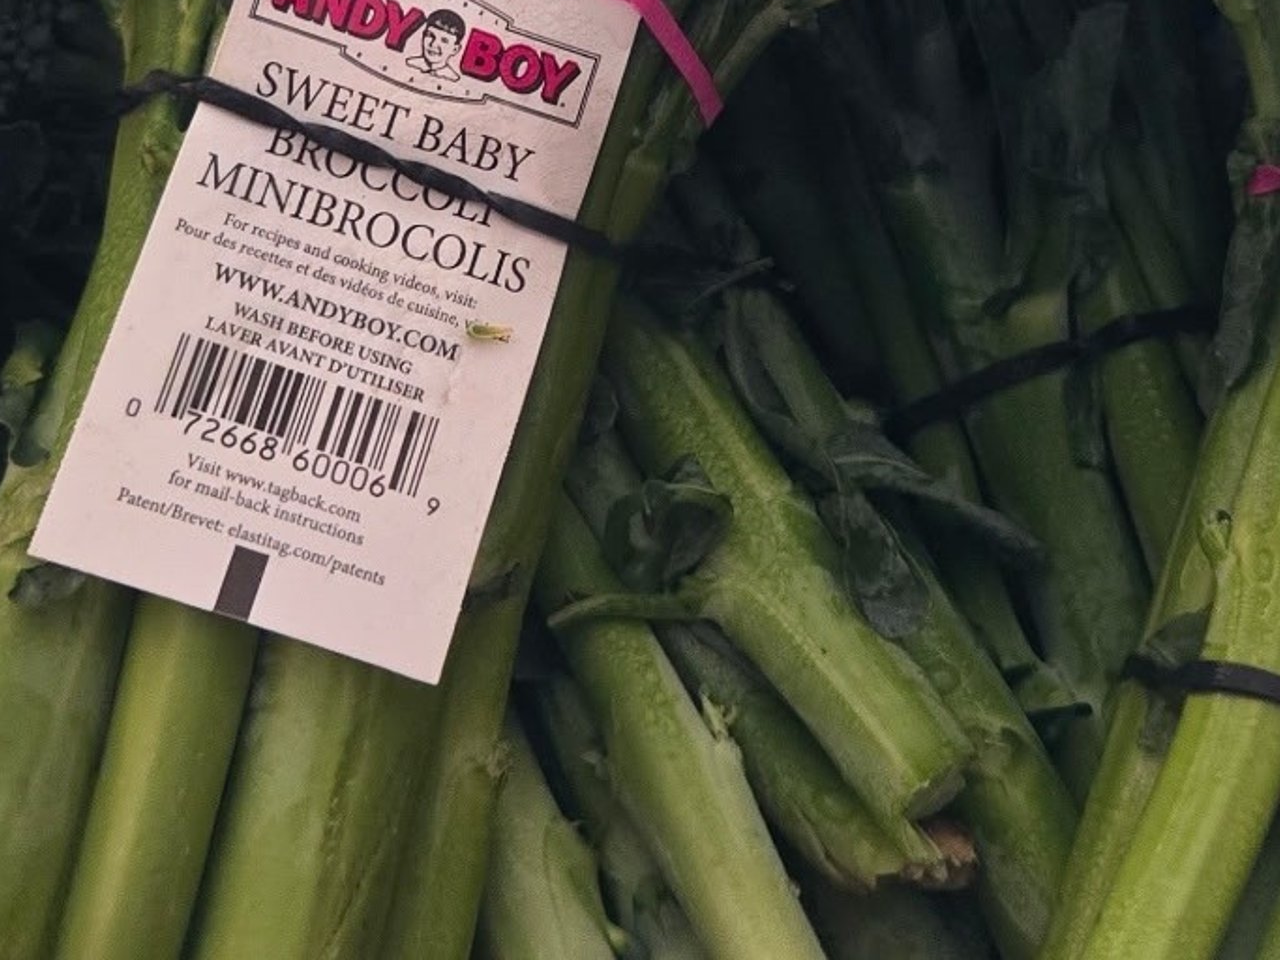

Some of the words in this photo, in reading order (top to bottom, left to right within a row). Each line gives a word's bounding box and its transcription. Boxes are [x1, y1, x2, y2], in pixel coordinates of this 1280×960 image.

[458, 26, 581, 106] BOY
[250, 60, 411, 141] SWEET
[411, 113, 536, 182] BABY
[195, 151, 531, 293] MINIBROCOLIS
[264, 124, 502, 228] BROCCOLI
[173, 216, 211, 241] Pour
[211, 230, 237, 250] des
[237, 242, 292, 269] recettes
[294, 263, 310, 276] et
[310, 265, 337, 286] des
[338, 277, 384, 301] vidéos
[385, 290, 405, 308] de
[405, 300, 460, 329] cuisine,
[222, 211, 250, 232] For
[249, 224, 301, 250] recipes
[302, 242, 332, 260] and
[332, 253, 390, 284] cooking
[392, 272, 440, 299] videos,
[444, 289, 478, 309] visit:
[203, 315, 263, 348] LAVER
[263, 337, 327, 368] AVANT
[214, 261, 460, 362] WWW.ANDYBOY.COM
[234, 300, 285, 331] WASH
[285, 320, 355, 356] BEFORE
[357, 344, 413, 375] USING
[124, 396, 142, 418] 0
[182, 408, 279, 461] 72668
[291, 447, 394, 498] 60006
[426, 496, 441, 516] 9
[187, 451, 222, 478] Visit
[224, 468, 361, 524] www.tagback.com
[115, 485, 225, 533] Patent/Brevet:
[226, 522, 386, 586] elastitag.com/patents
[166, 468, 193, 489] for
[193, 481, 271, 516] mail-back
[272, 503, 365, 546] instructions
